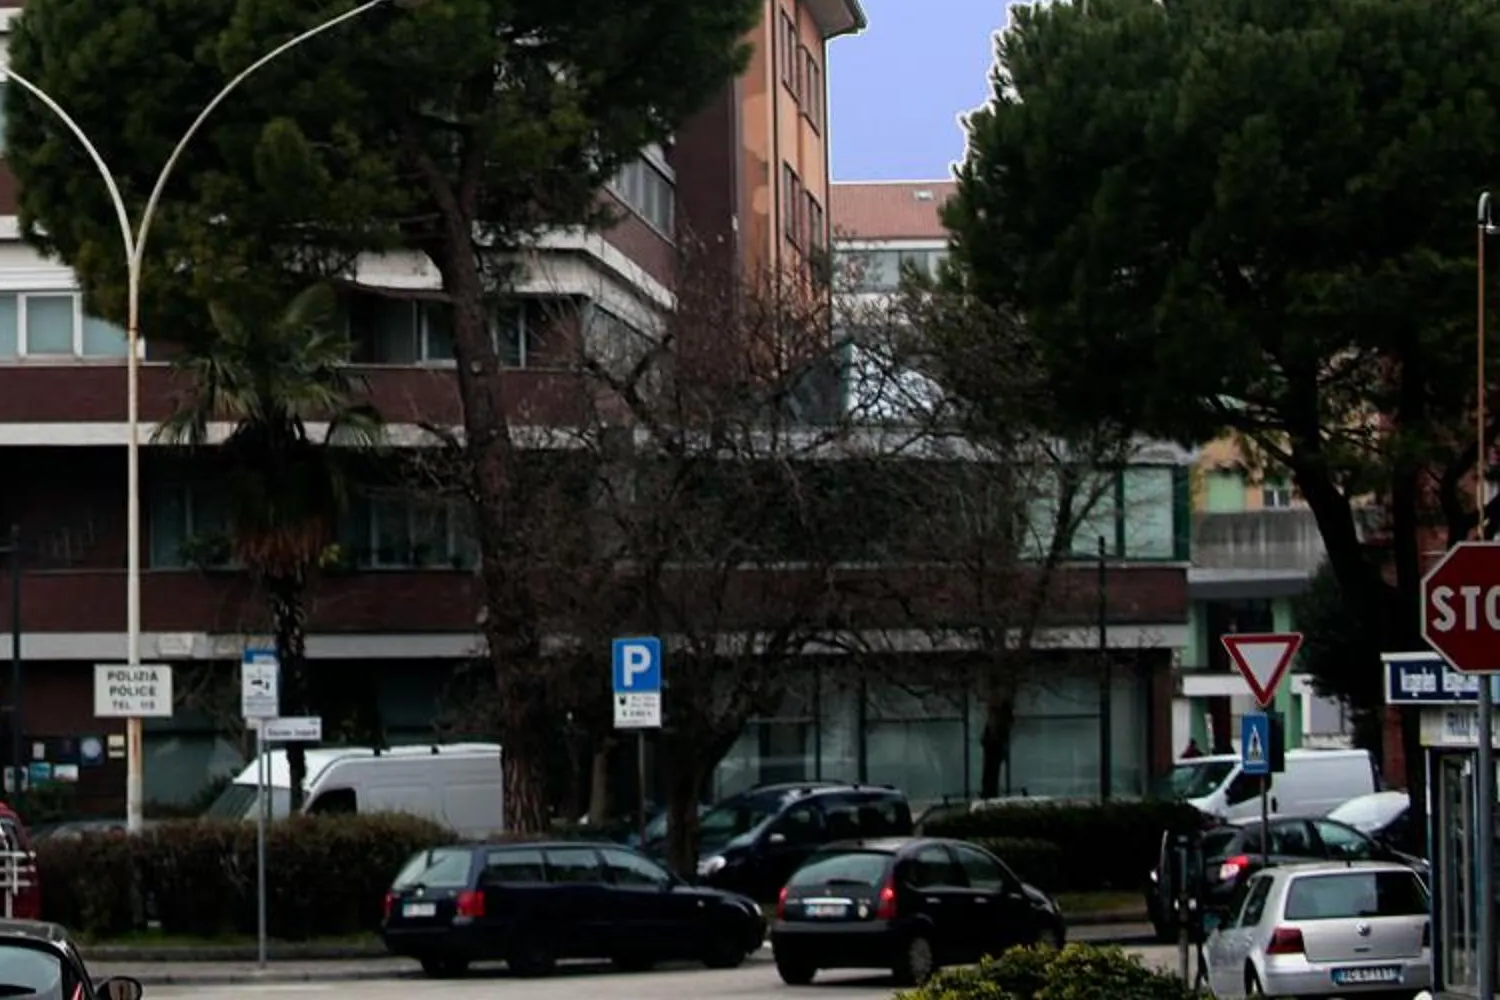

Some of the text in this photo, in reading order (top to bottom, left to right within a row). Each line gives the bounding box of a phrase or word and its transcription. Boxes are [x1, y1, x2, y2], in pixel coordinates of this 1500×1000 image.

[623, 645, 651, 687] P
[107, 670, 159, 681] POLIZIA
[109, 685, 156, 697] POLICE
